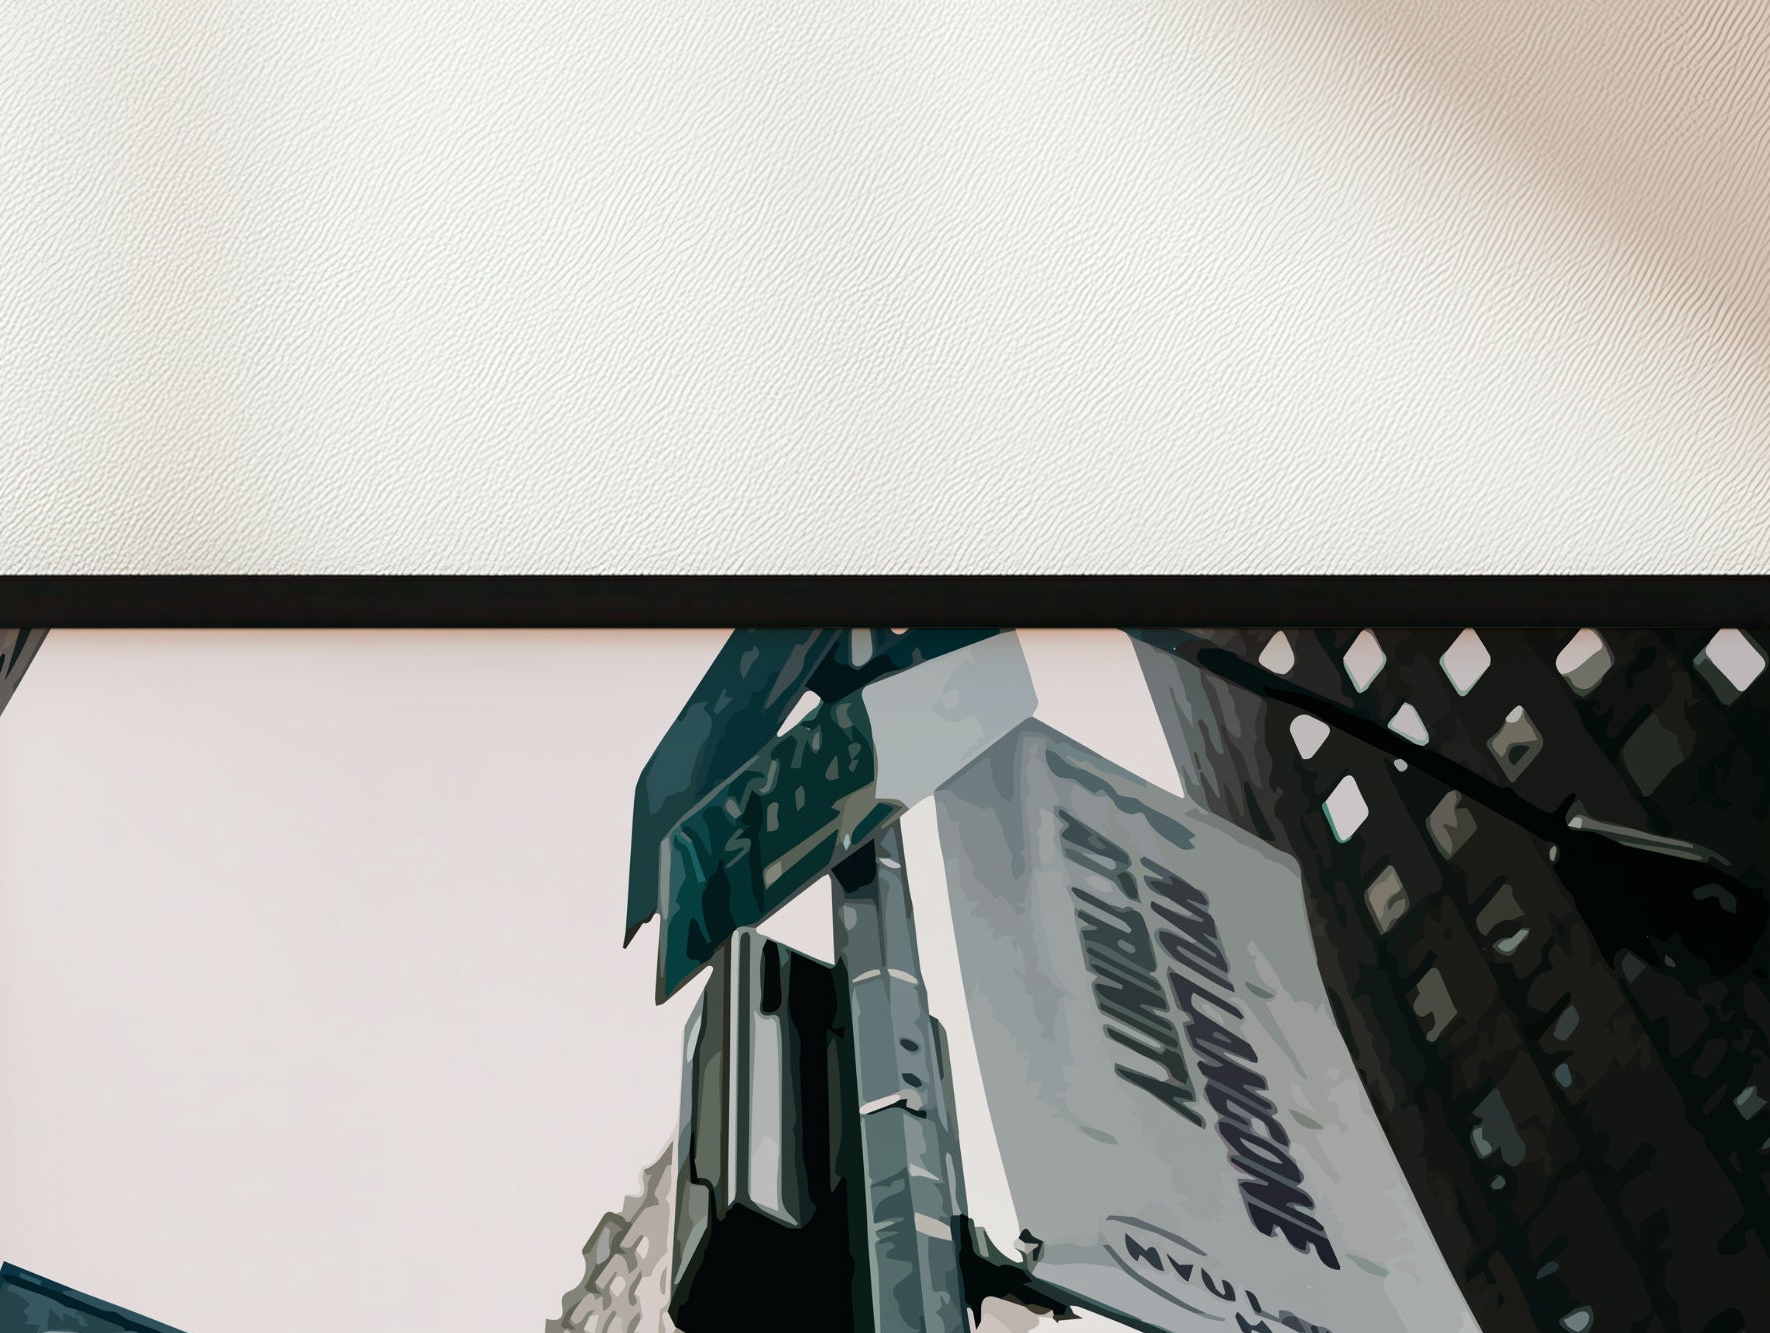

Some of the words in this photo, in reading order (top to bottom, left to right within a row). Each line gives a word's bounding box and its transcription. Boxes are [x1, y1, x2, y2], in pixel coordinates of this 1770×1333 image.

[1071, 886, 1205, 1128] TRINITY
[1139, 856, 1235, 993] NYU
[1167, 966, 1341, 1270] LANGONE
